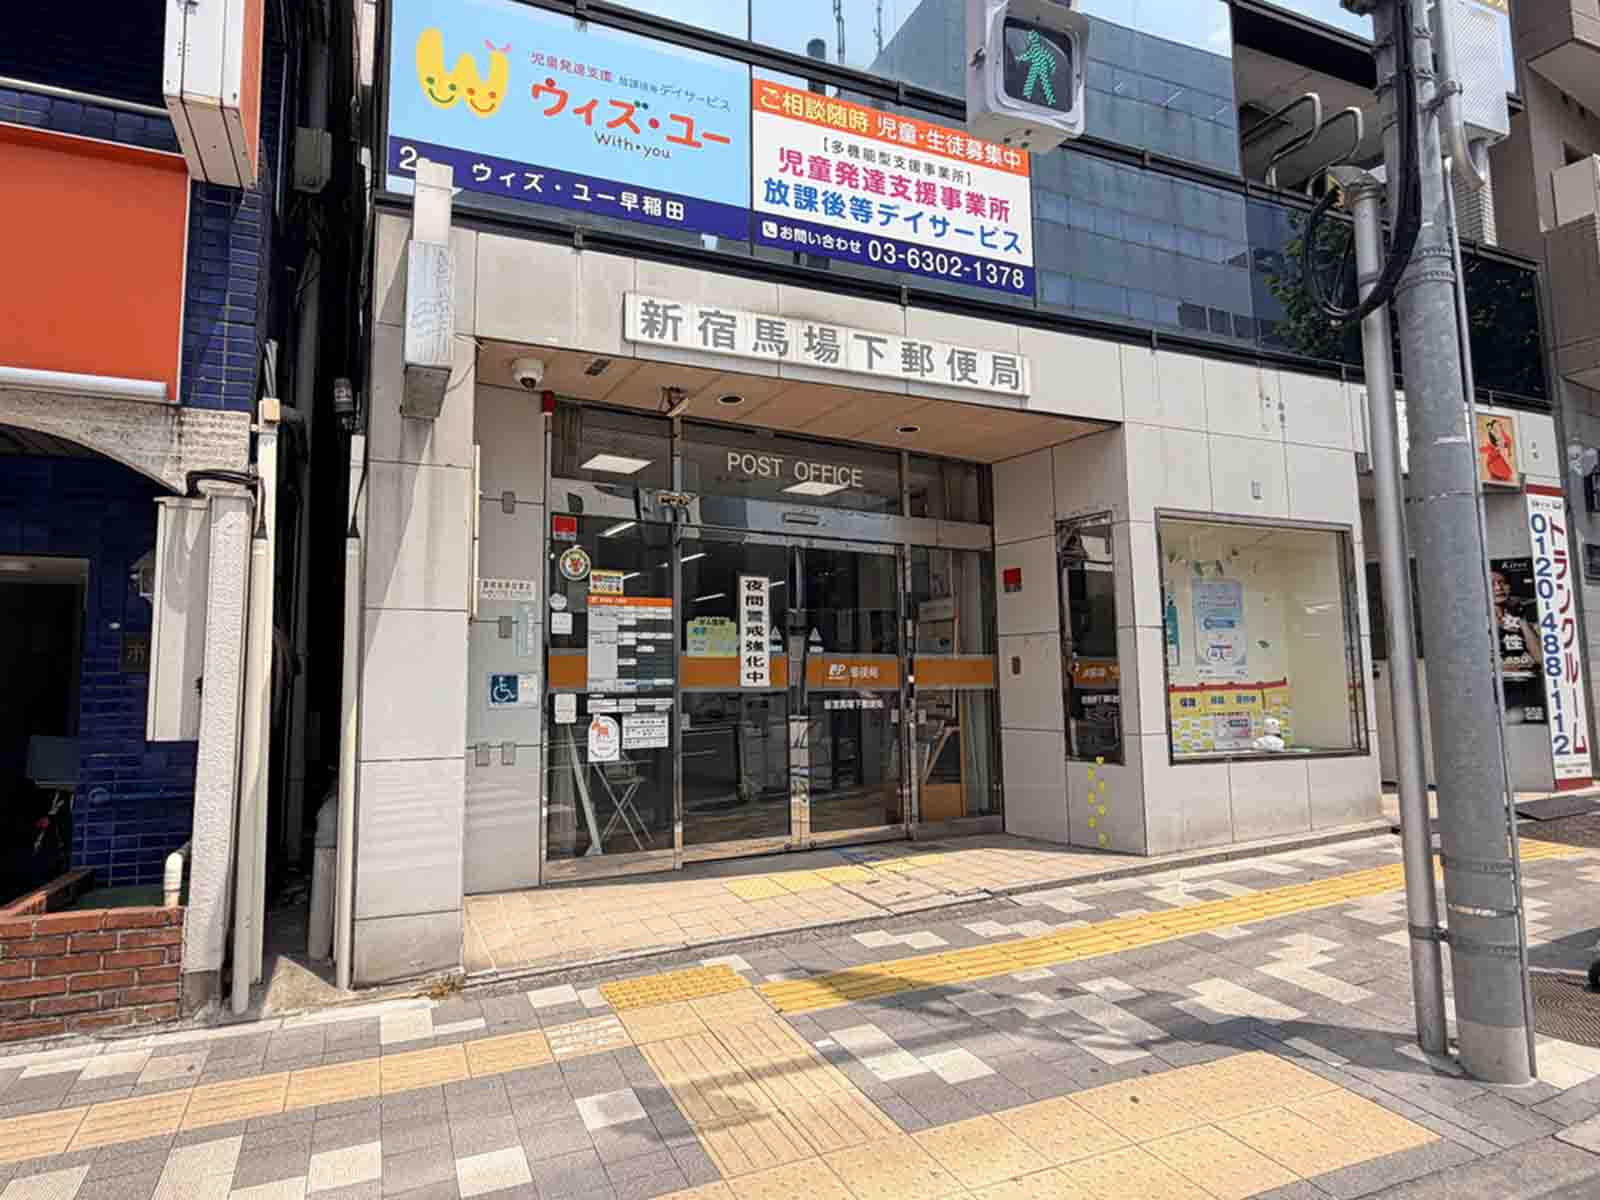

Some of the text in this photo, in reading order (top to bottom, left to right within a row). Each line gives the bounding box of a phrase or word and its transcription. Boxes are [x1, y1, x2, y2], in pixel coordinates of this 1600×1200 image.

[760, 87, 1022, 168] ご相談随時 児童・生徒募集中
[764, 177, 1023, 254] 放課後等デイサービス
[778, 146, 1010, 224] 児童発達支援事業所
[780, 225, 1025, 289] お問い合わせ 03-6302-1378
[640, 299, 1020, 390] 新宿馬場下郵便局
[727, 451, 864, 488] POST OFFICE
[1531, 513, 1570, 756] 0120-488-112
[1549, 515, 1588, 754] トランクルーム
